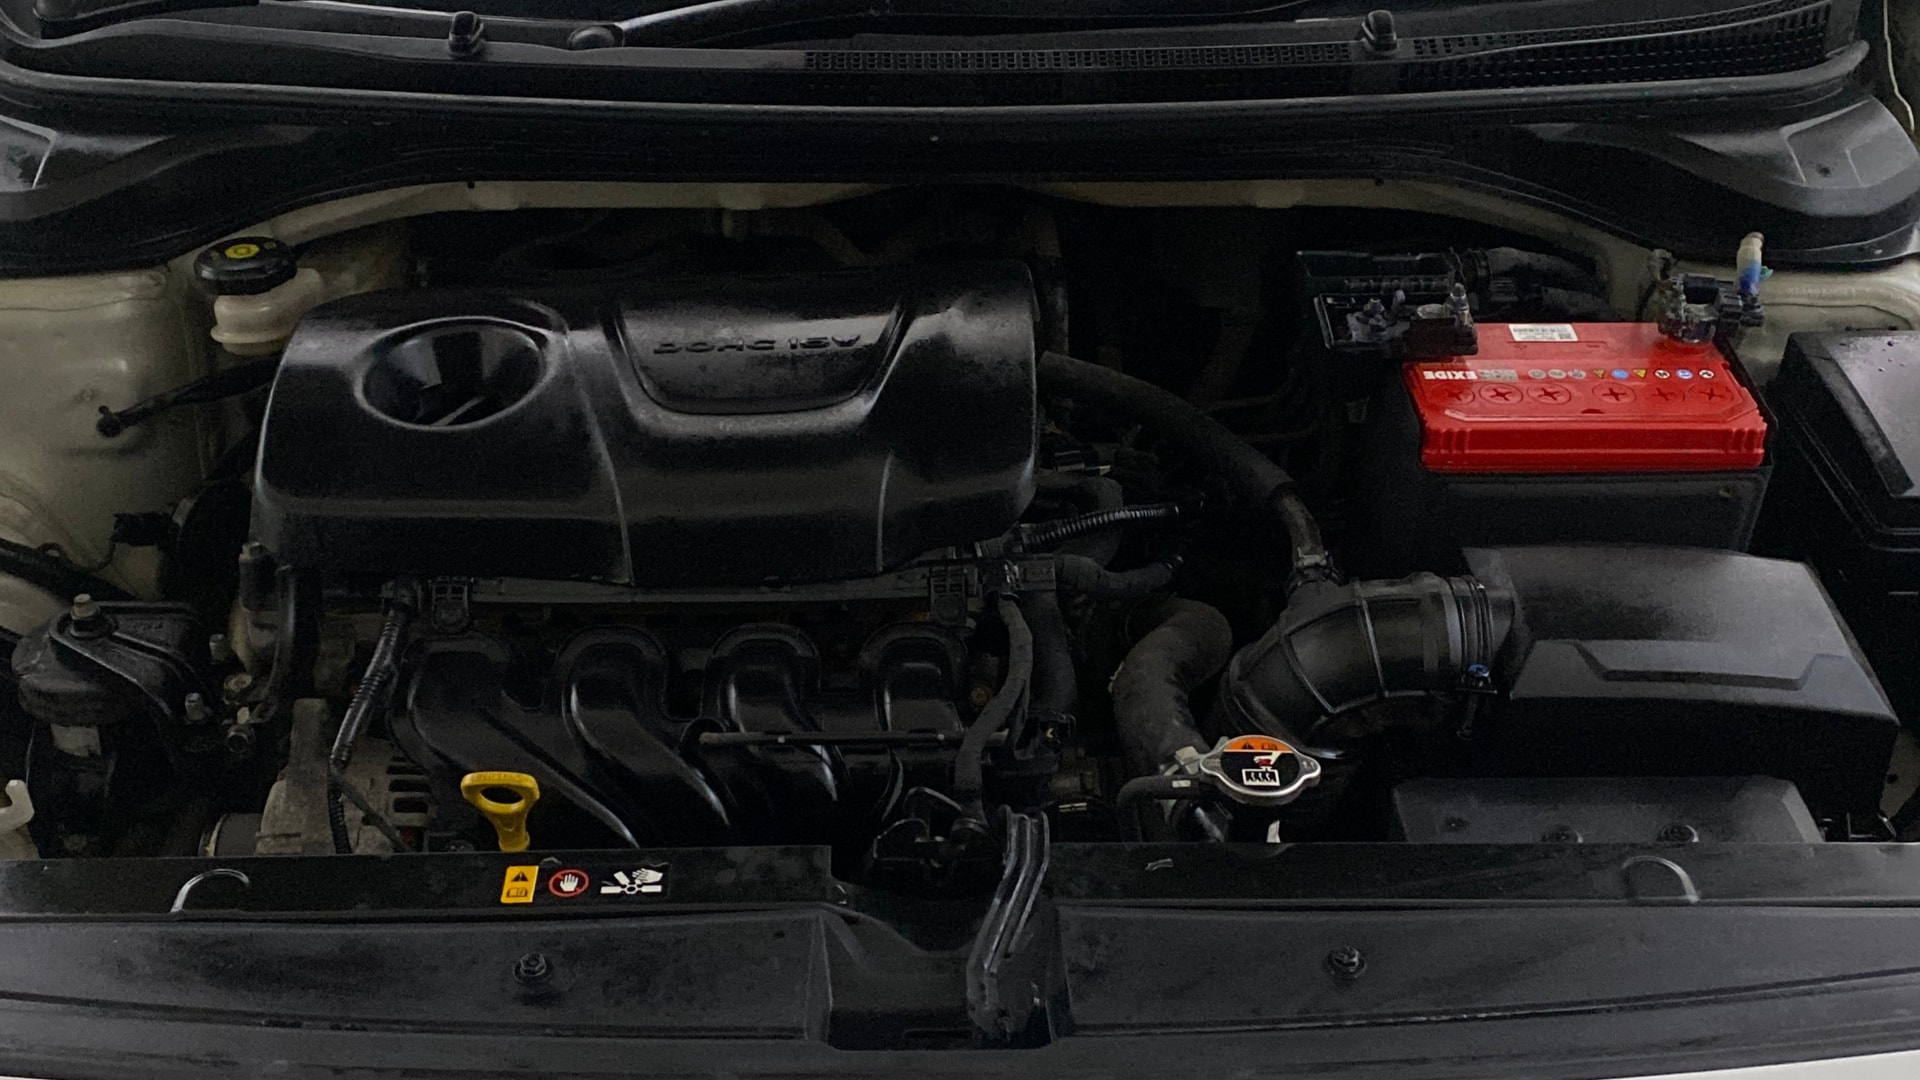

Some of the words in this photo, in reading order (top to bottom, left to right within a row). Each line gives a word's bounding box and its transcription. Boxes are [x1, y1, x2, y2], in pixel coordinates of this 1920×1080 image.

[653, 338, 776, 354] DOHC
[788, 334, 861, 350] 16V
[1423, 370, 1478, 380] EXIDE
